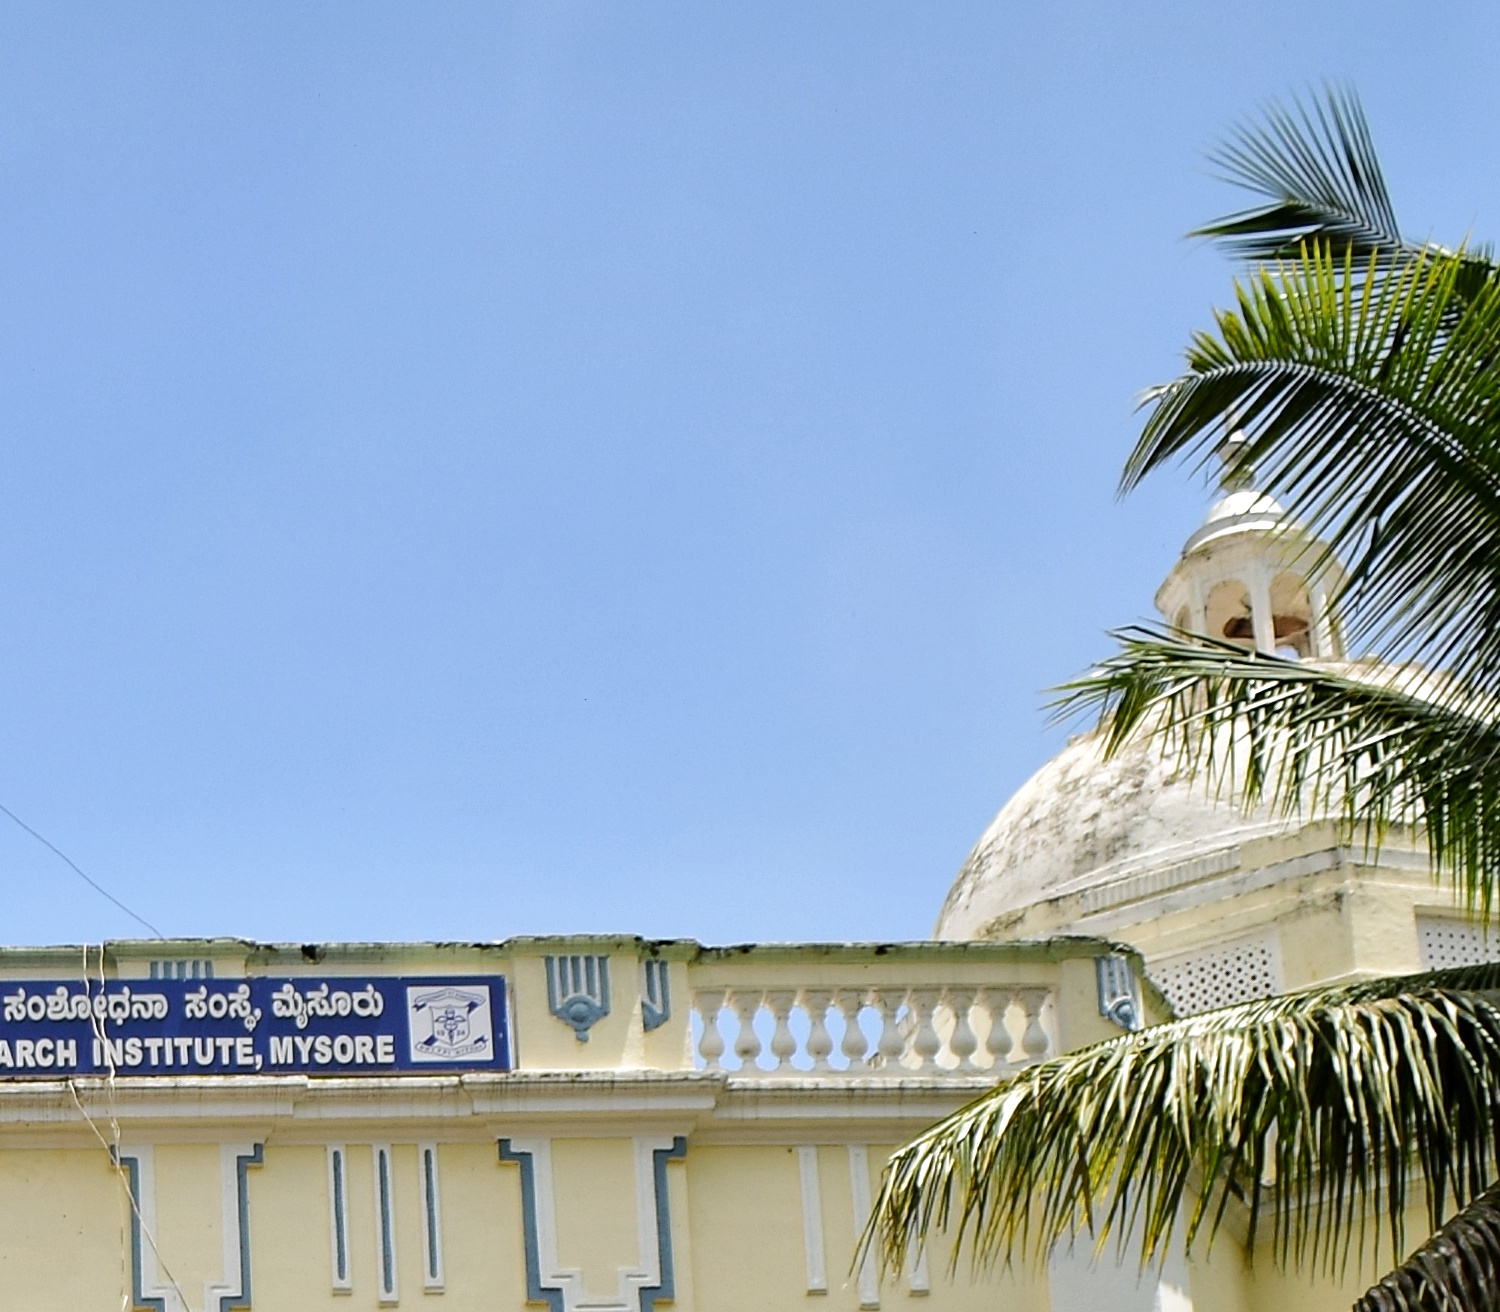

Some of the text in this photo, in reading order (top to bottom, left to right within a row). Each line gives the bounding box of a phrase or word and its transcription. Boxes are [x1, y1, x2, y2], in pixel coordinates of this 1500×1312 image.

[272, 983, 384, 1029] ಮೈಸೂರು
[93, 1036, 264, 1071] INSTITUTE,
[270, 1035, 395, 1066] MYSORE
